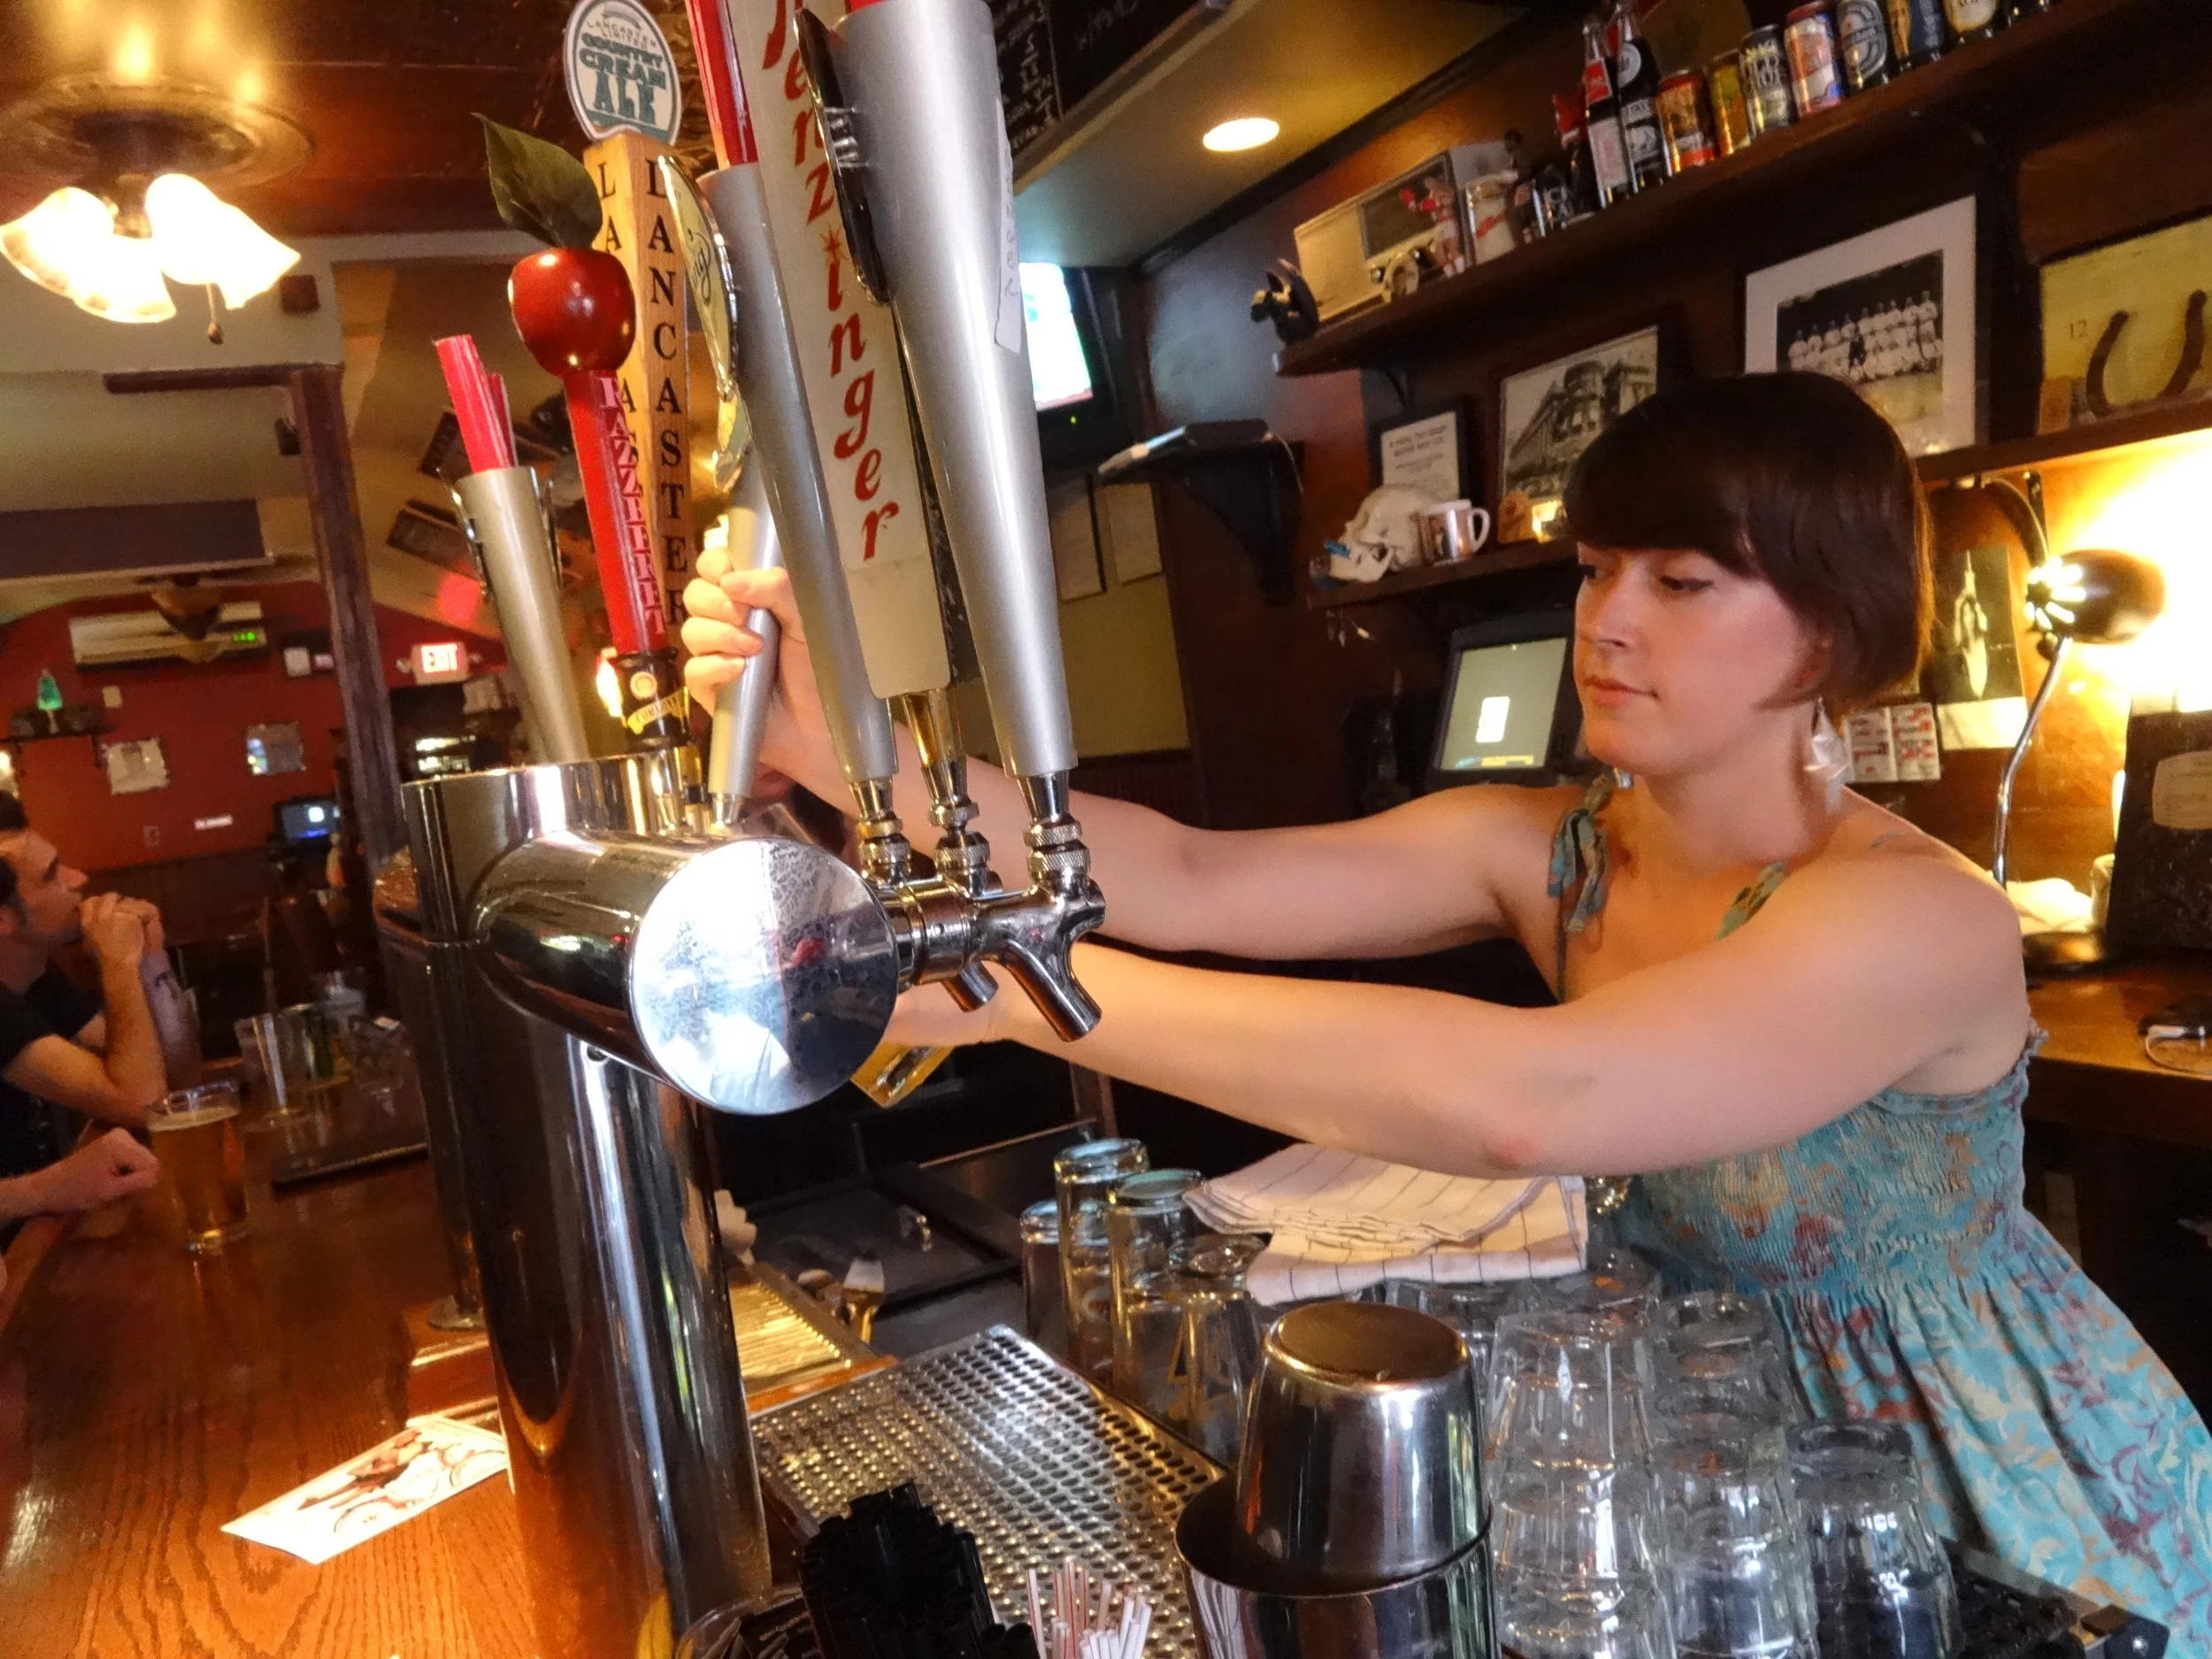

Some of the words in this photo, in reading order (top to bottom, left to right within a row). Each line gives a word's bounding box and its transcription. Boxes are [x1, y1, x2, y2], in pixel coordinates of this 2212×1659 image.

[580, 49, 667, 90] CREAM
[581, 33, 663, 69] COUNTRY
[594, 70, 656, 126] ALE
[762, 0, 900, 561] enzinger
[646, 159, 687, 625] LANCASTER
[421, 644, 457, 672] EXIT
